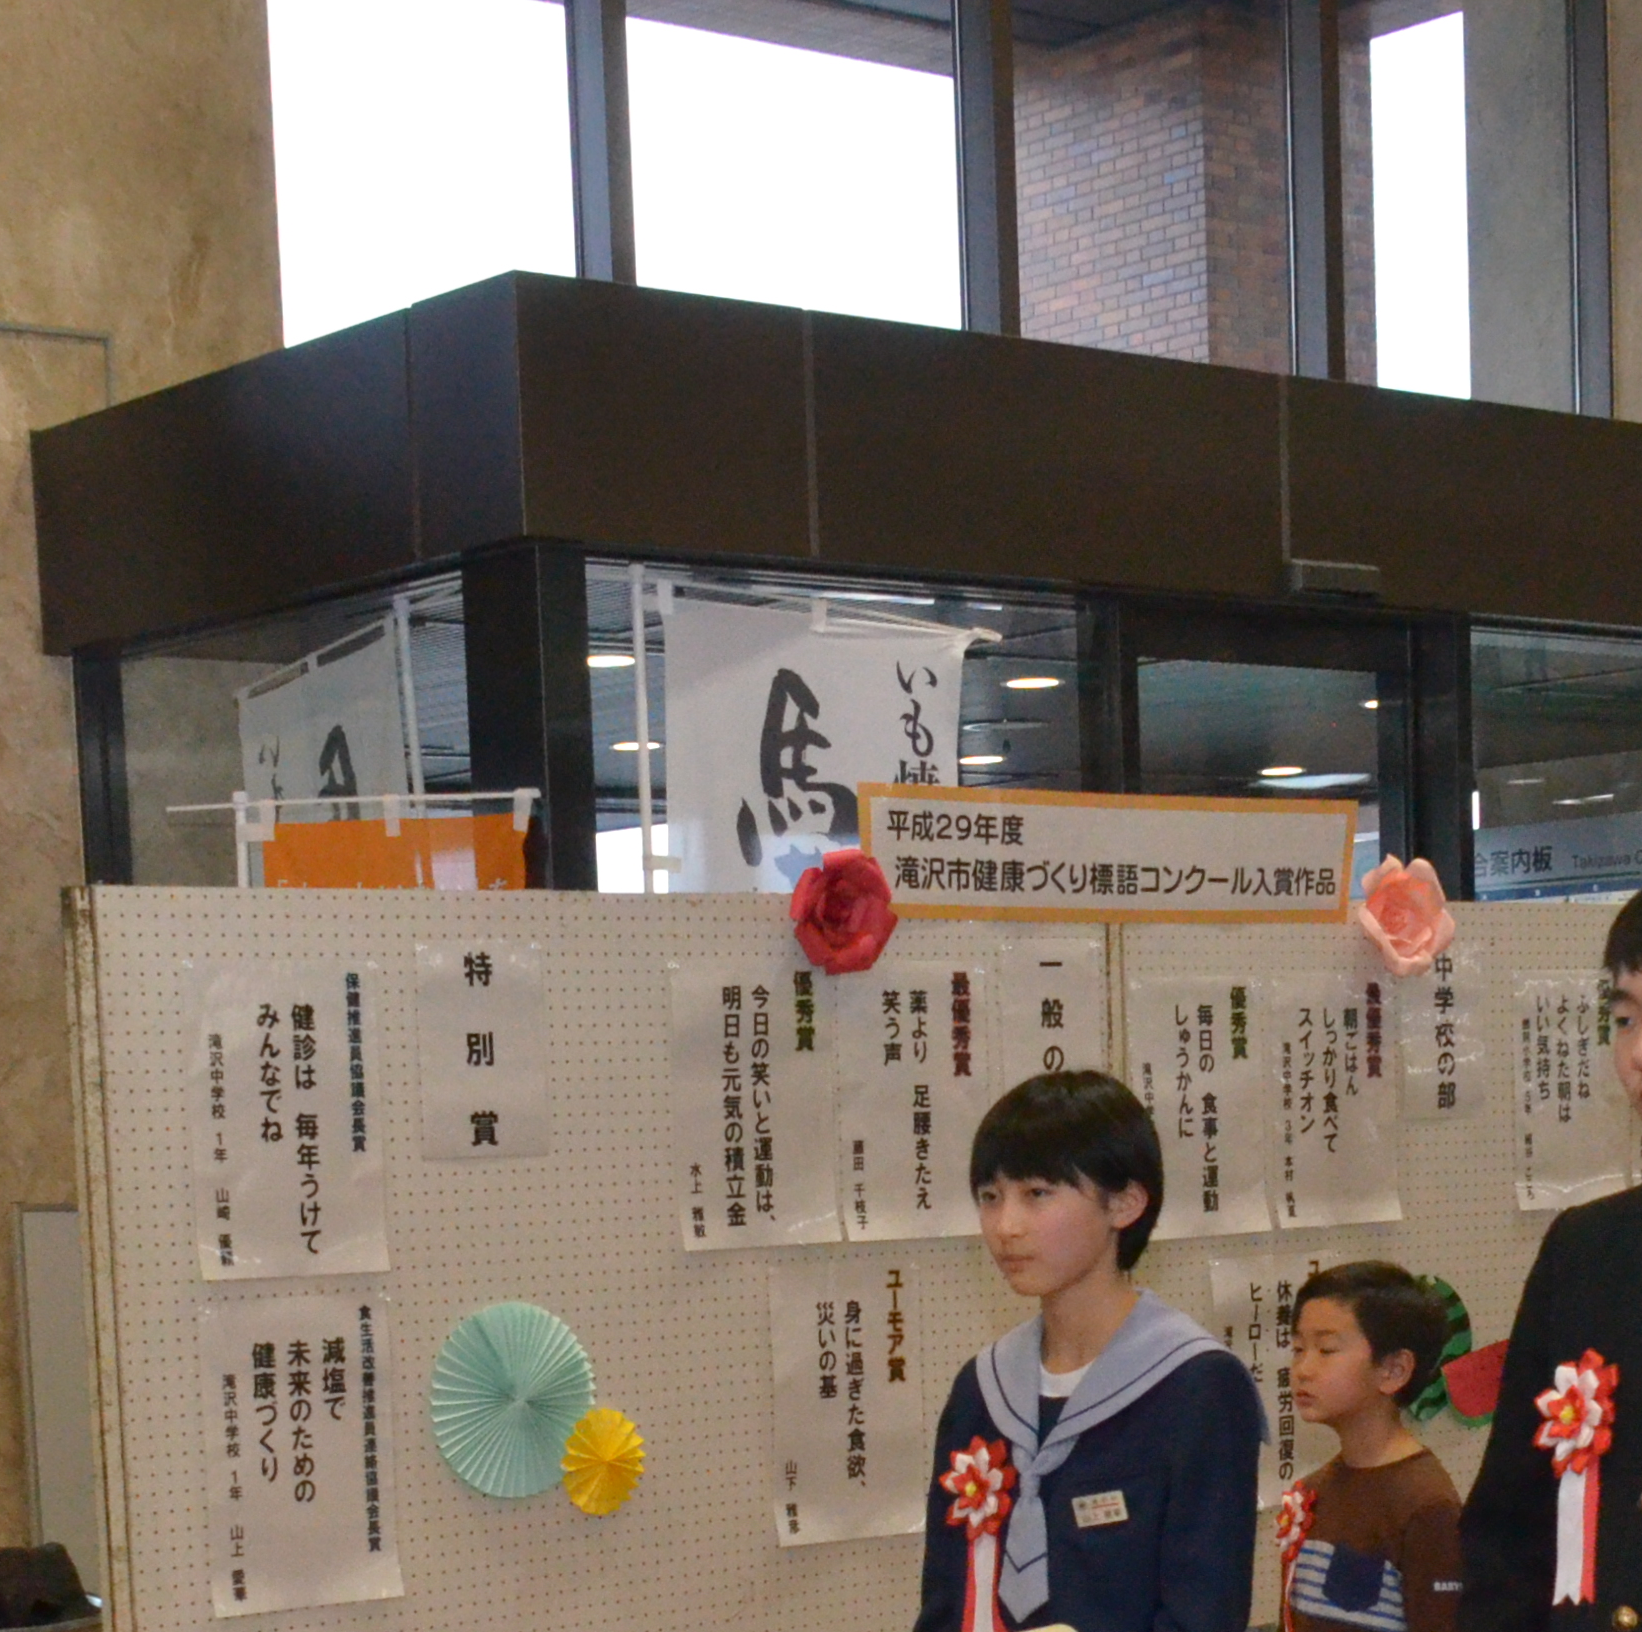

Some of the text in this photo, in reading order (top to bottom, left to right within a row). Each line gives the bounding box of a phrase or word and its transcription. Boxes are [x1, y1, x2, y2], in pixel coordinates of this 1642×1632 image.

[887, 809, 1024, 846] 平成29年度
[894, 856, 1337, 897] 滝沢市健康づくり標語コンクール入賞作品
[793, 971, 816, 1052] 優秀賞
[882, 989, 903, 1067] 笑う声
[951, 972, 972, 1077] 最優秀賞
[1229, 985, 1248, 1060] 優秀賞
[1535, 994, 1551, 1101] いい気持ち
[1556, 994, 1572, 1123] よくねた朝は
[1576, 994, 1591, 1099] ふしぎだね
[208, 1033, 226, 1120] 滝沢中学校
[257, 1003, 284, 1144] みんなでね
[291, 1003, 322, 1255] 健診は 毎年うけて
[721, 985, 747, 1228] 明日も元気の積立金
[751, 984, 777, 1222] 今日の笑いと運動は、
[909, 989, 932, 1211] 薬より 足腰きたえ
[1173, 1004, 1195, 1139] しゅうかんに
[1197, 1003, 1219, 1213] 毎日の 食事と運動
[1298, 1007, 1316, 1136] スイッチオン
[1322, 1007, 1340, 1154] しっかり食べて
[321, 1336, 347, 1420] 減塩で
[815, 1300, 838, 1399] 災いの基
[885, 1269, 907, 1384] ユーモア賞
[221, 1373, 241, 1458] 滝沢中学校
[252, 1342, 279, 1482] 健康づくり
[287, 1340, 316, 1503] 未来のための
[844, 1299, 867, 1488] 身に過ぎた食欲、
[229, 1524, 244, 1557] 山上
